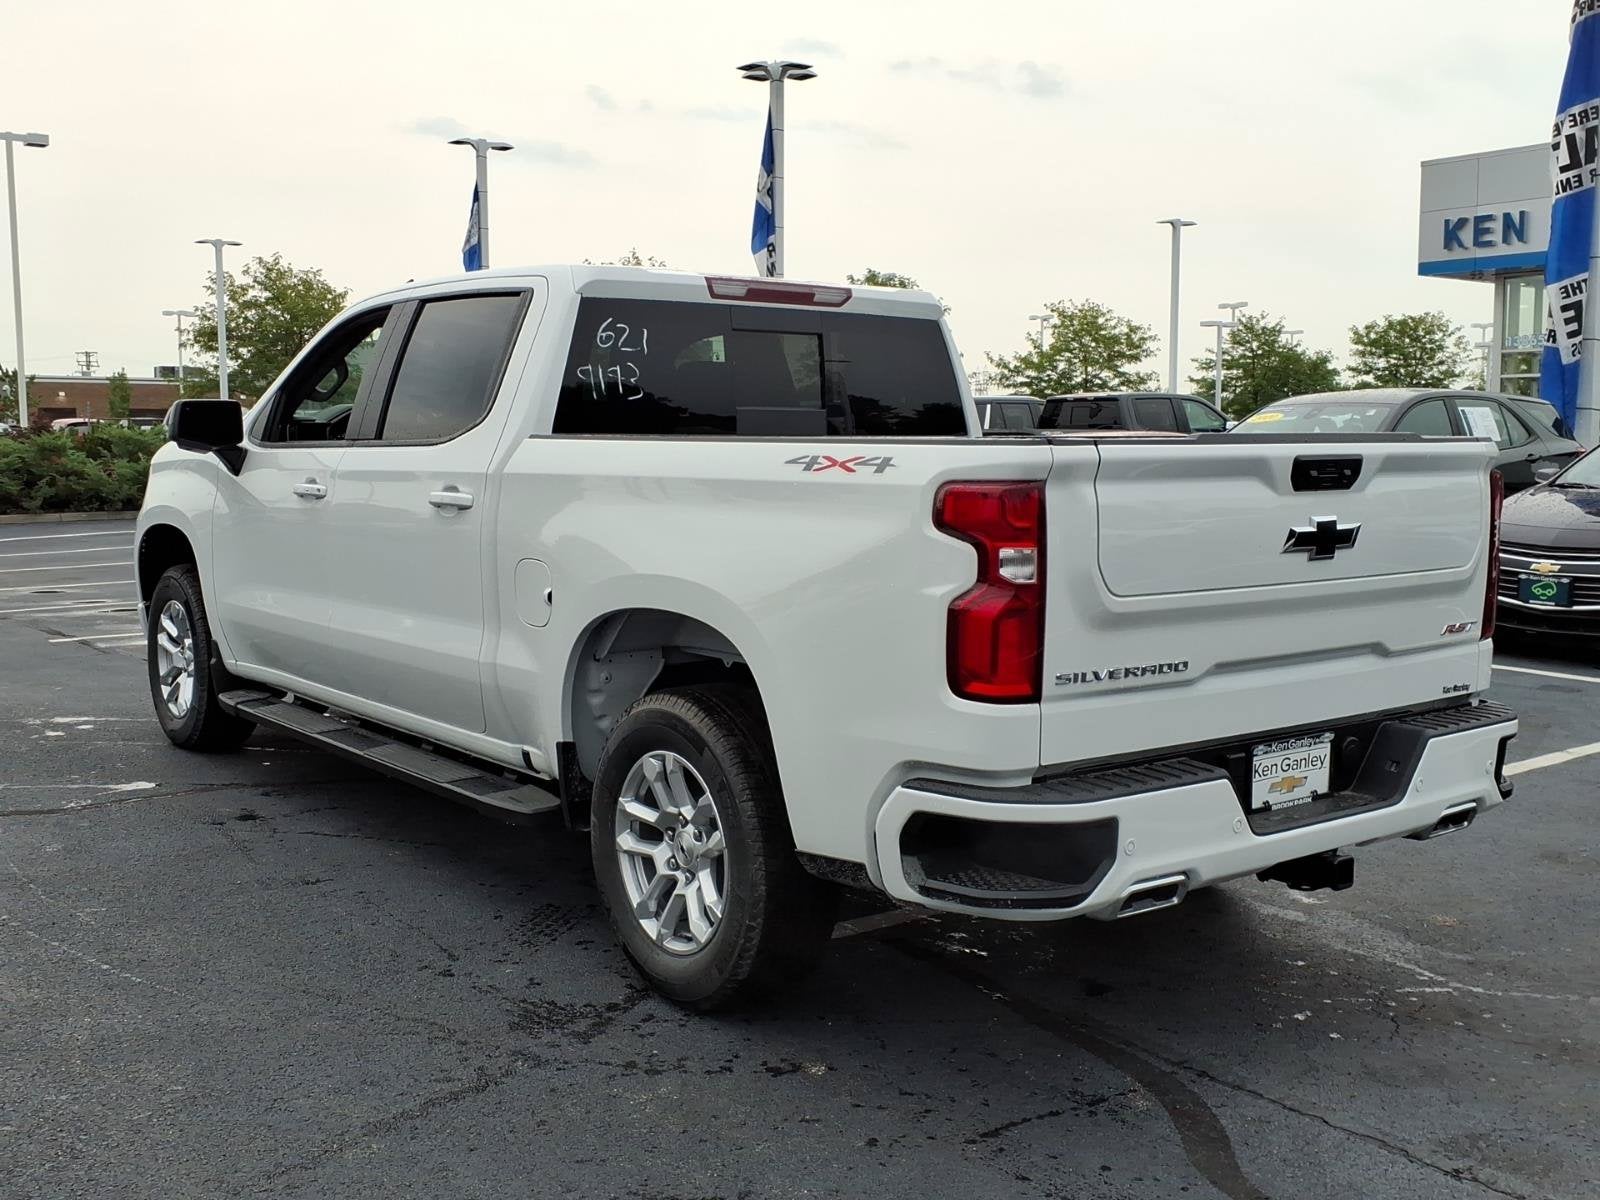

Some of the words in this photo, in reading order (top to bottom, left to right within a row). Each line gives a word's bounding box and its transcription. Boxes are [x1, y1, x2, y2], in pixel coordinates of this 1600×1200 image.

[1443, 210, 1528, 251] KEN
[597, 317, 648, 355] 621
[1440, 621, 1477, 636] RST
[1055, 660, 1189, 686] SILVERADO
[1271, 741, 1288, 752] Ken
[1288, 736, 1316, 750] Ganley
[1253, 762, 1278, 779] Ken
[1281, 753, 1327, 773] Ganley
